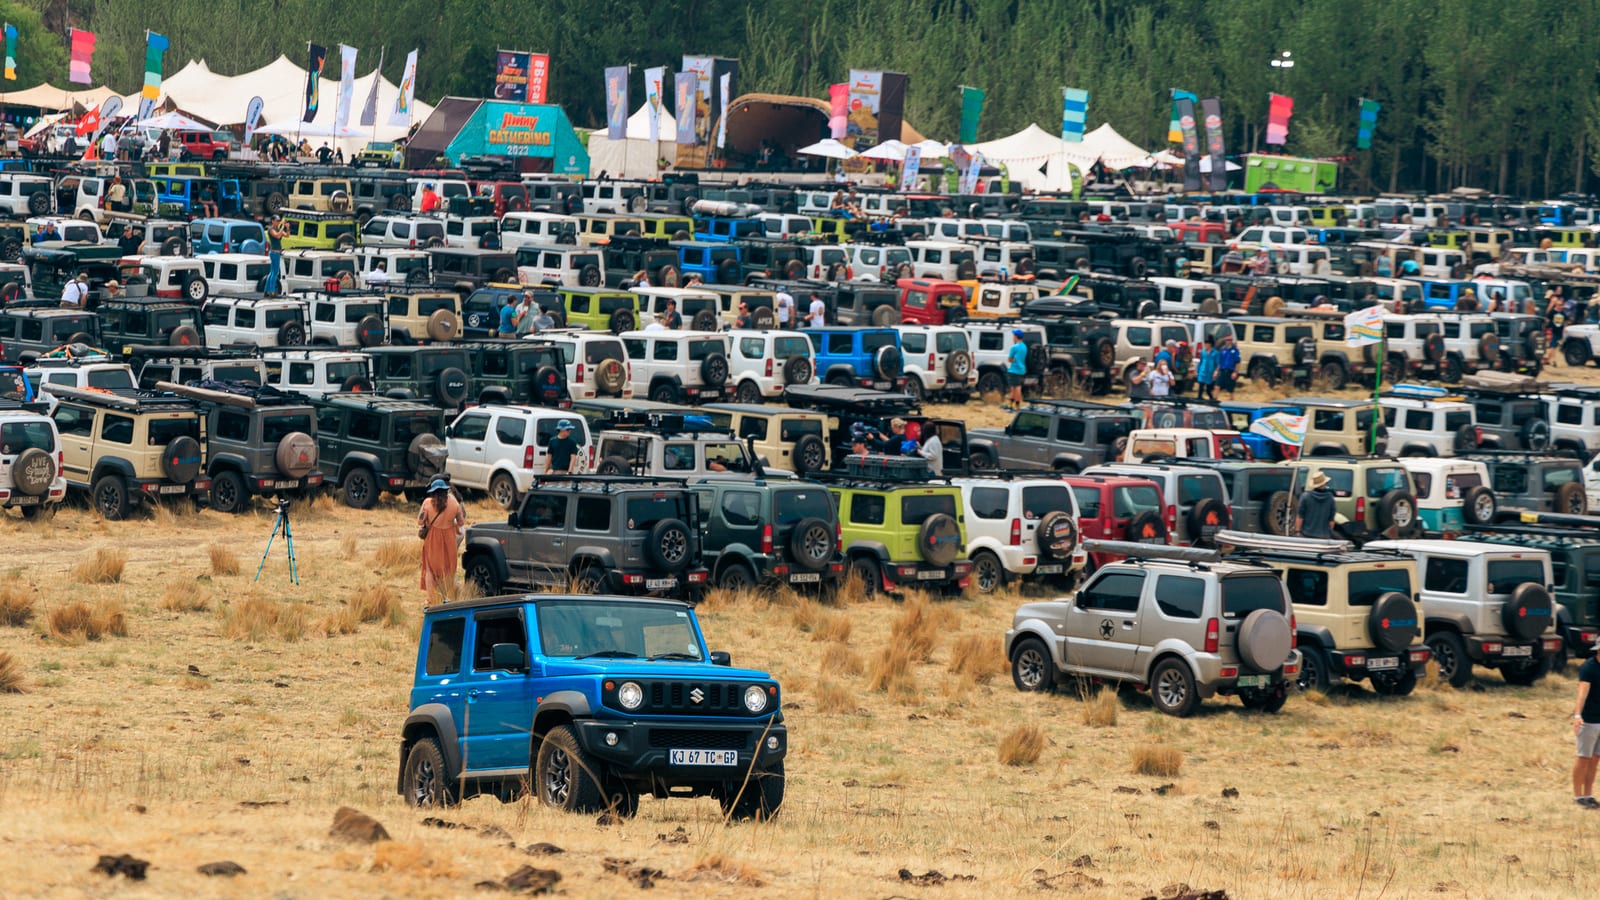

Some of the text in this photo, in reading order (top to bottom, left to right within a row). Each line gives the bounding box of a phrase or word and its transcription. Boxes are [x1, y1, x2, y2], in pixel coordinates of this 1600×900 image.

[501, 112, 538, 130] Jimny
[489, 129, 551, 146] GATHERING
[672, 751, 735, 764] KJ 67 TC GP
